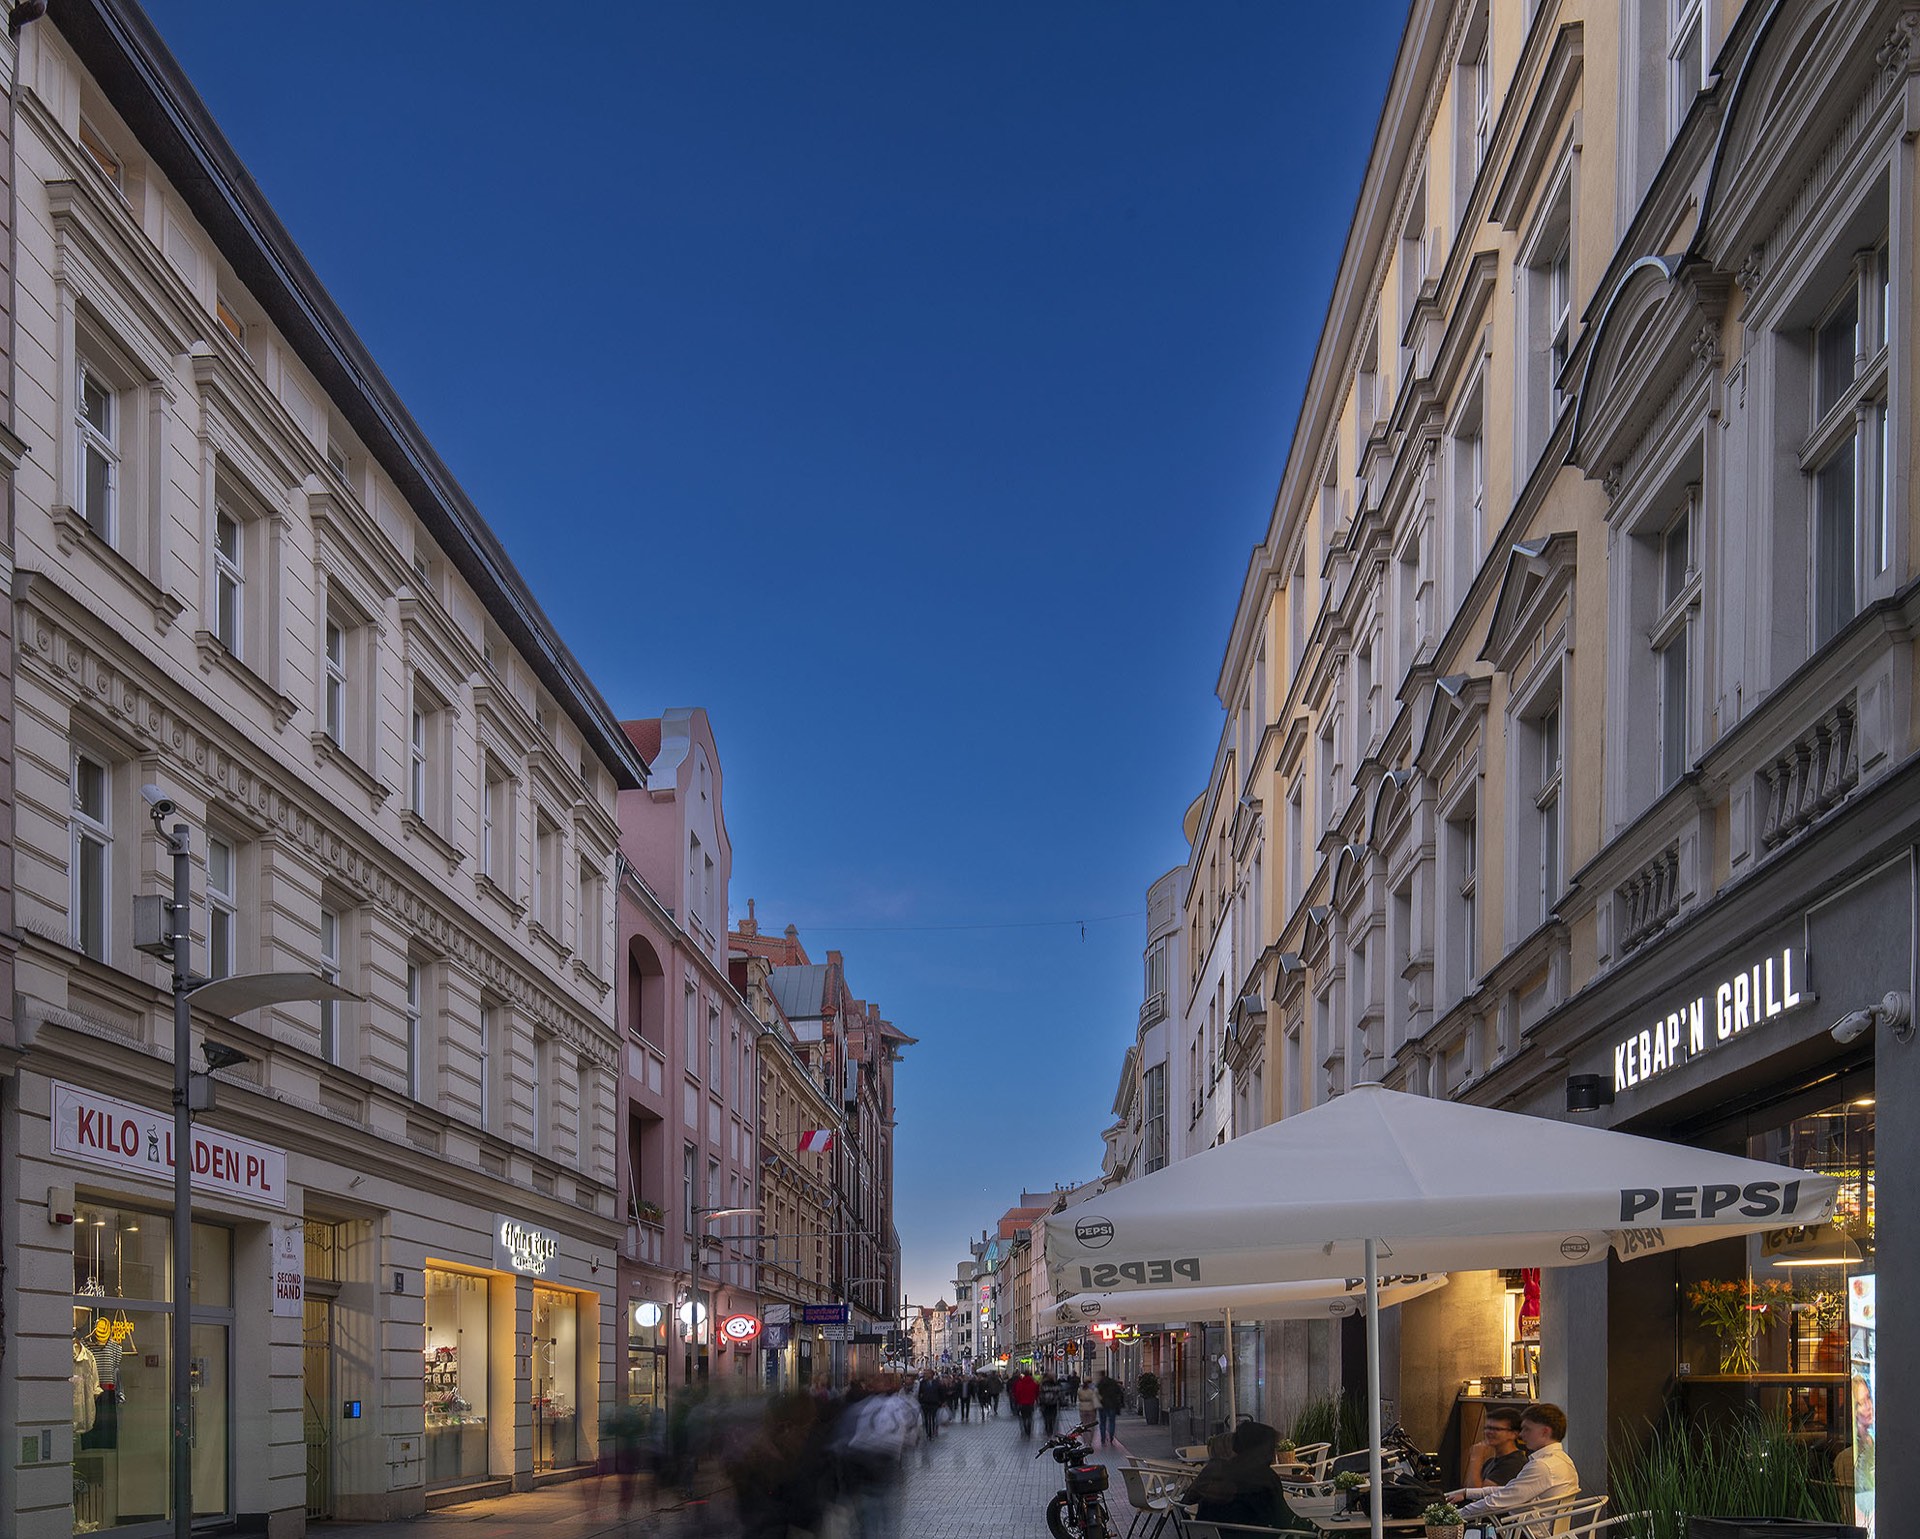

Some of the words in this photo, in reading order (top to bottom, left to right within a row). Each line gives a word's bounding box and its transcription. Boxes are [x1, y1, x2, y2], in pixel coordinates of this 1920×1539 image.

[1615, 997, 1704, 1093] KEBAP'N
[1717, 948, 1800, 1040] GRILL
[78, 1106, 139, 1157] KILO
[166, 1132, 240, 1183] LDEN
[246, 1156, 271, 1191] PL
[1620, 1180, 1801, 1222] PEPSI
[502, 1222, 532, 1257] flying
[534, 1232, 558, 1260] tiger
[1077, 1226, 1112, 1237] PEPSI
[277, 1271, 301, 1284] SECOND
[1345, 1273, 1428, 1291] PPSI
[277, 1284, 301, 1300] HAND
